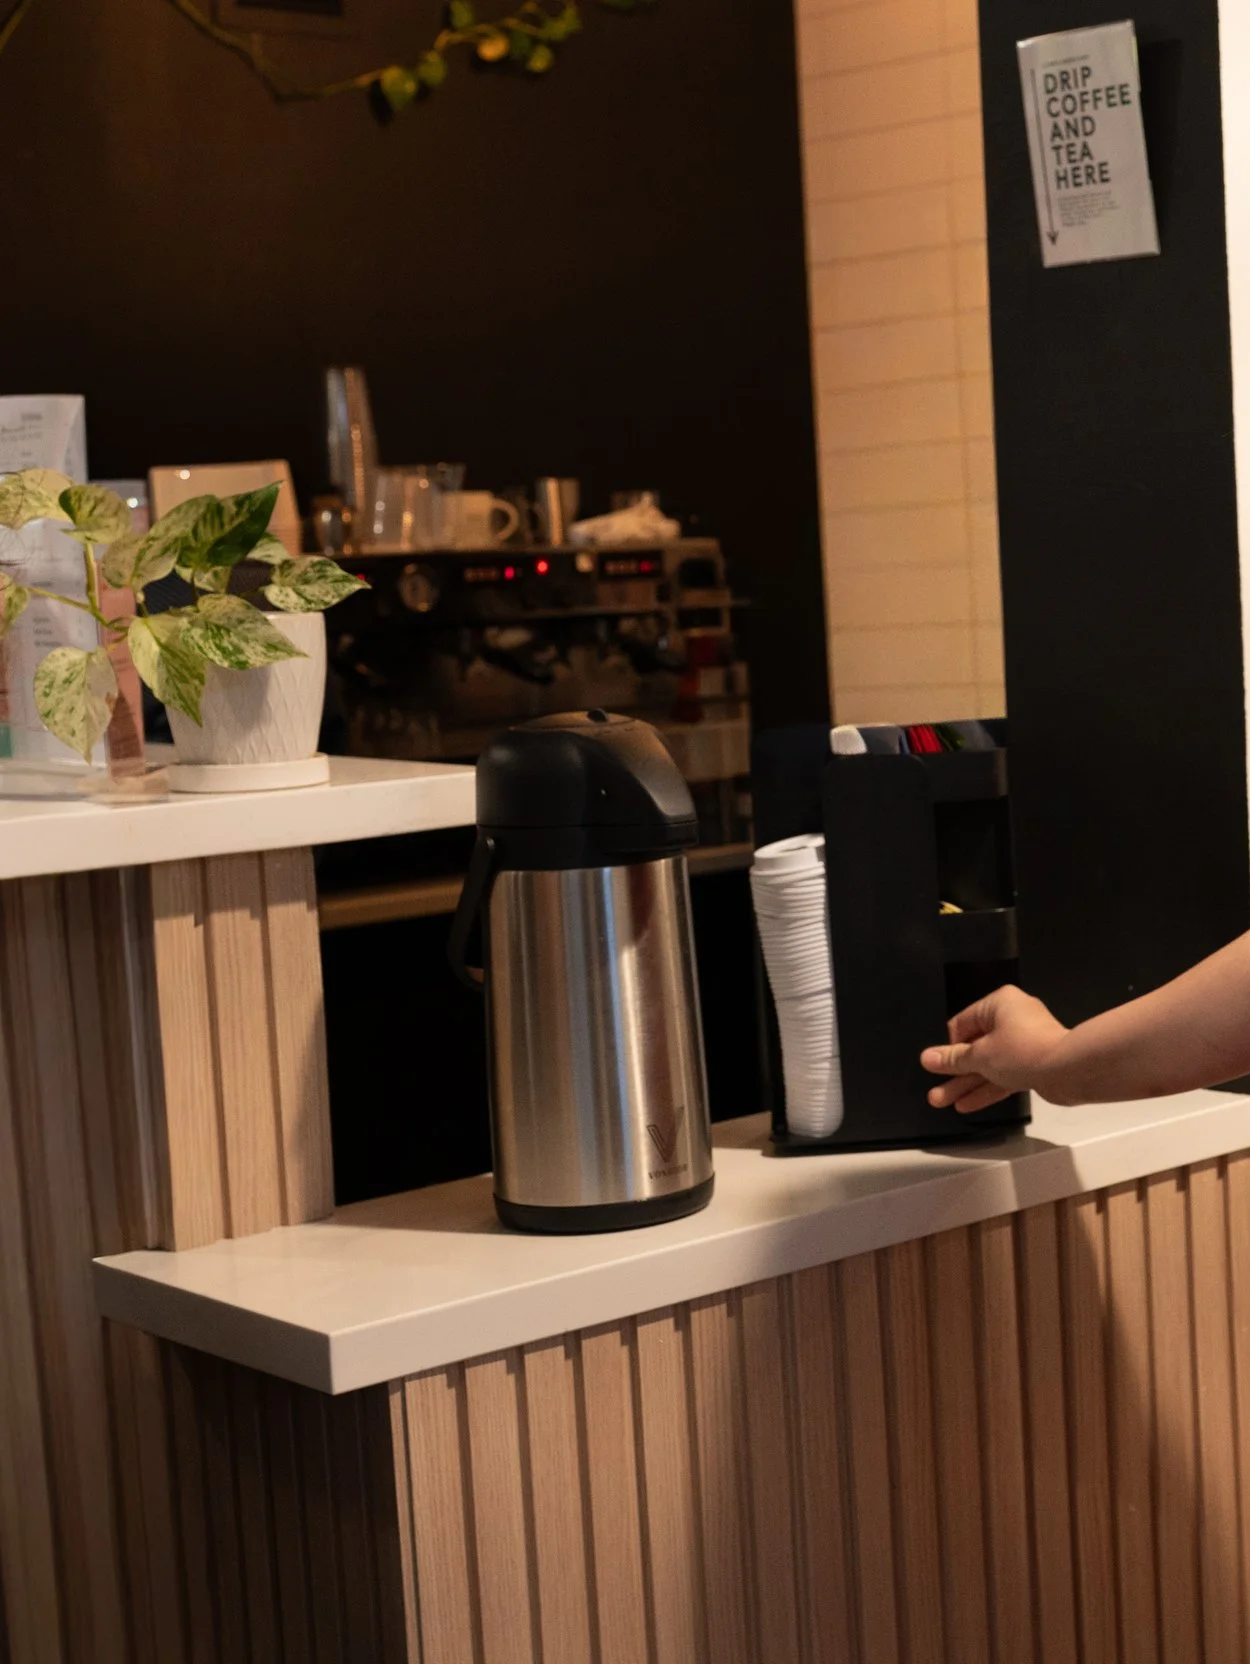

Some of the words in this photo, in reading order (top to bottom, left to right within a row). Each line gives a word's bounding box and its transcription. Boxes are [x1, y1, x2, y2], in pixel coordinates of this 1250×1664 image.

[1043, 66, 1092, 95] DRIP
[1046, 82, 1132, 118] COFFEE
[1050, 115, 1096, 142] AND
[1051, 141, 1093, 166] TEA
[1055, 161, 1111, 190] HERE
